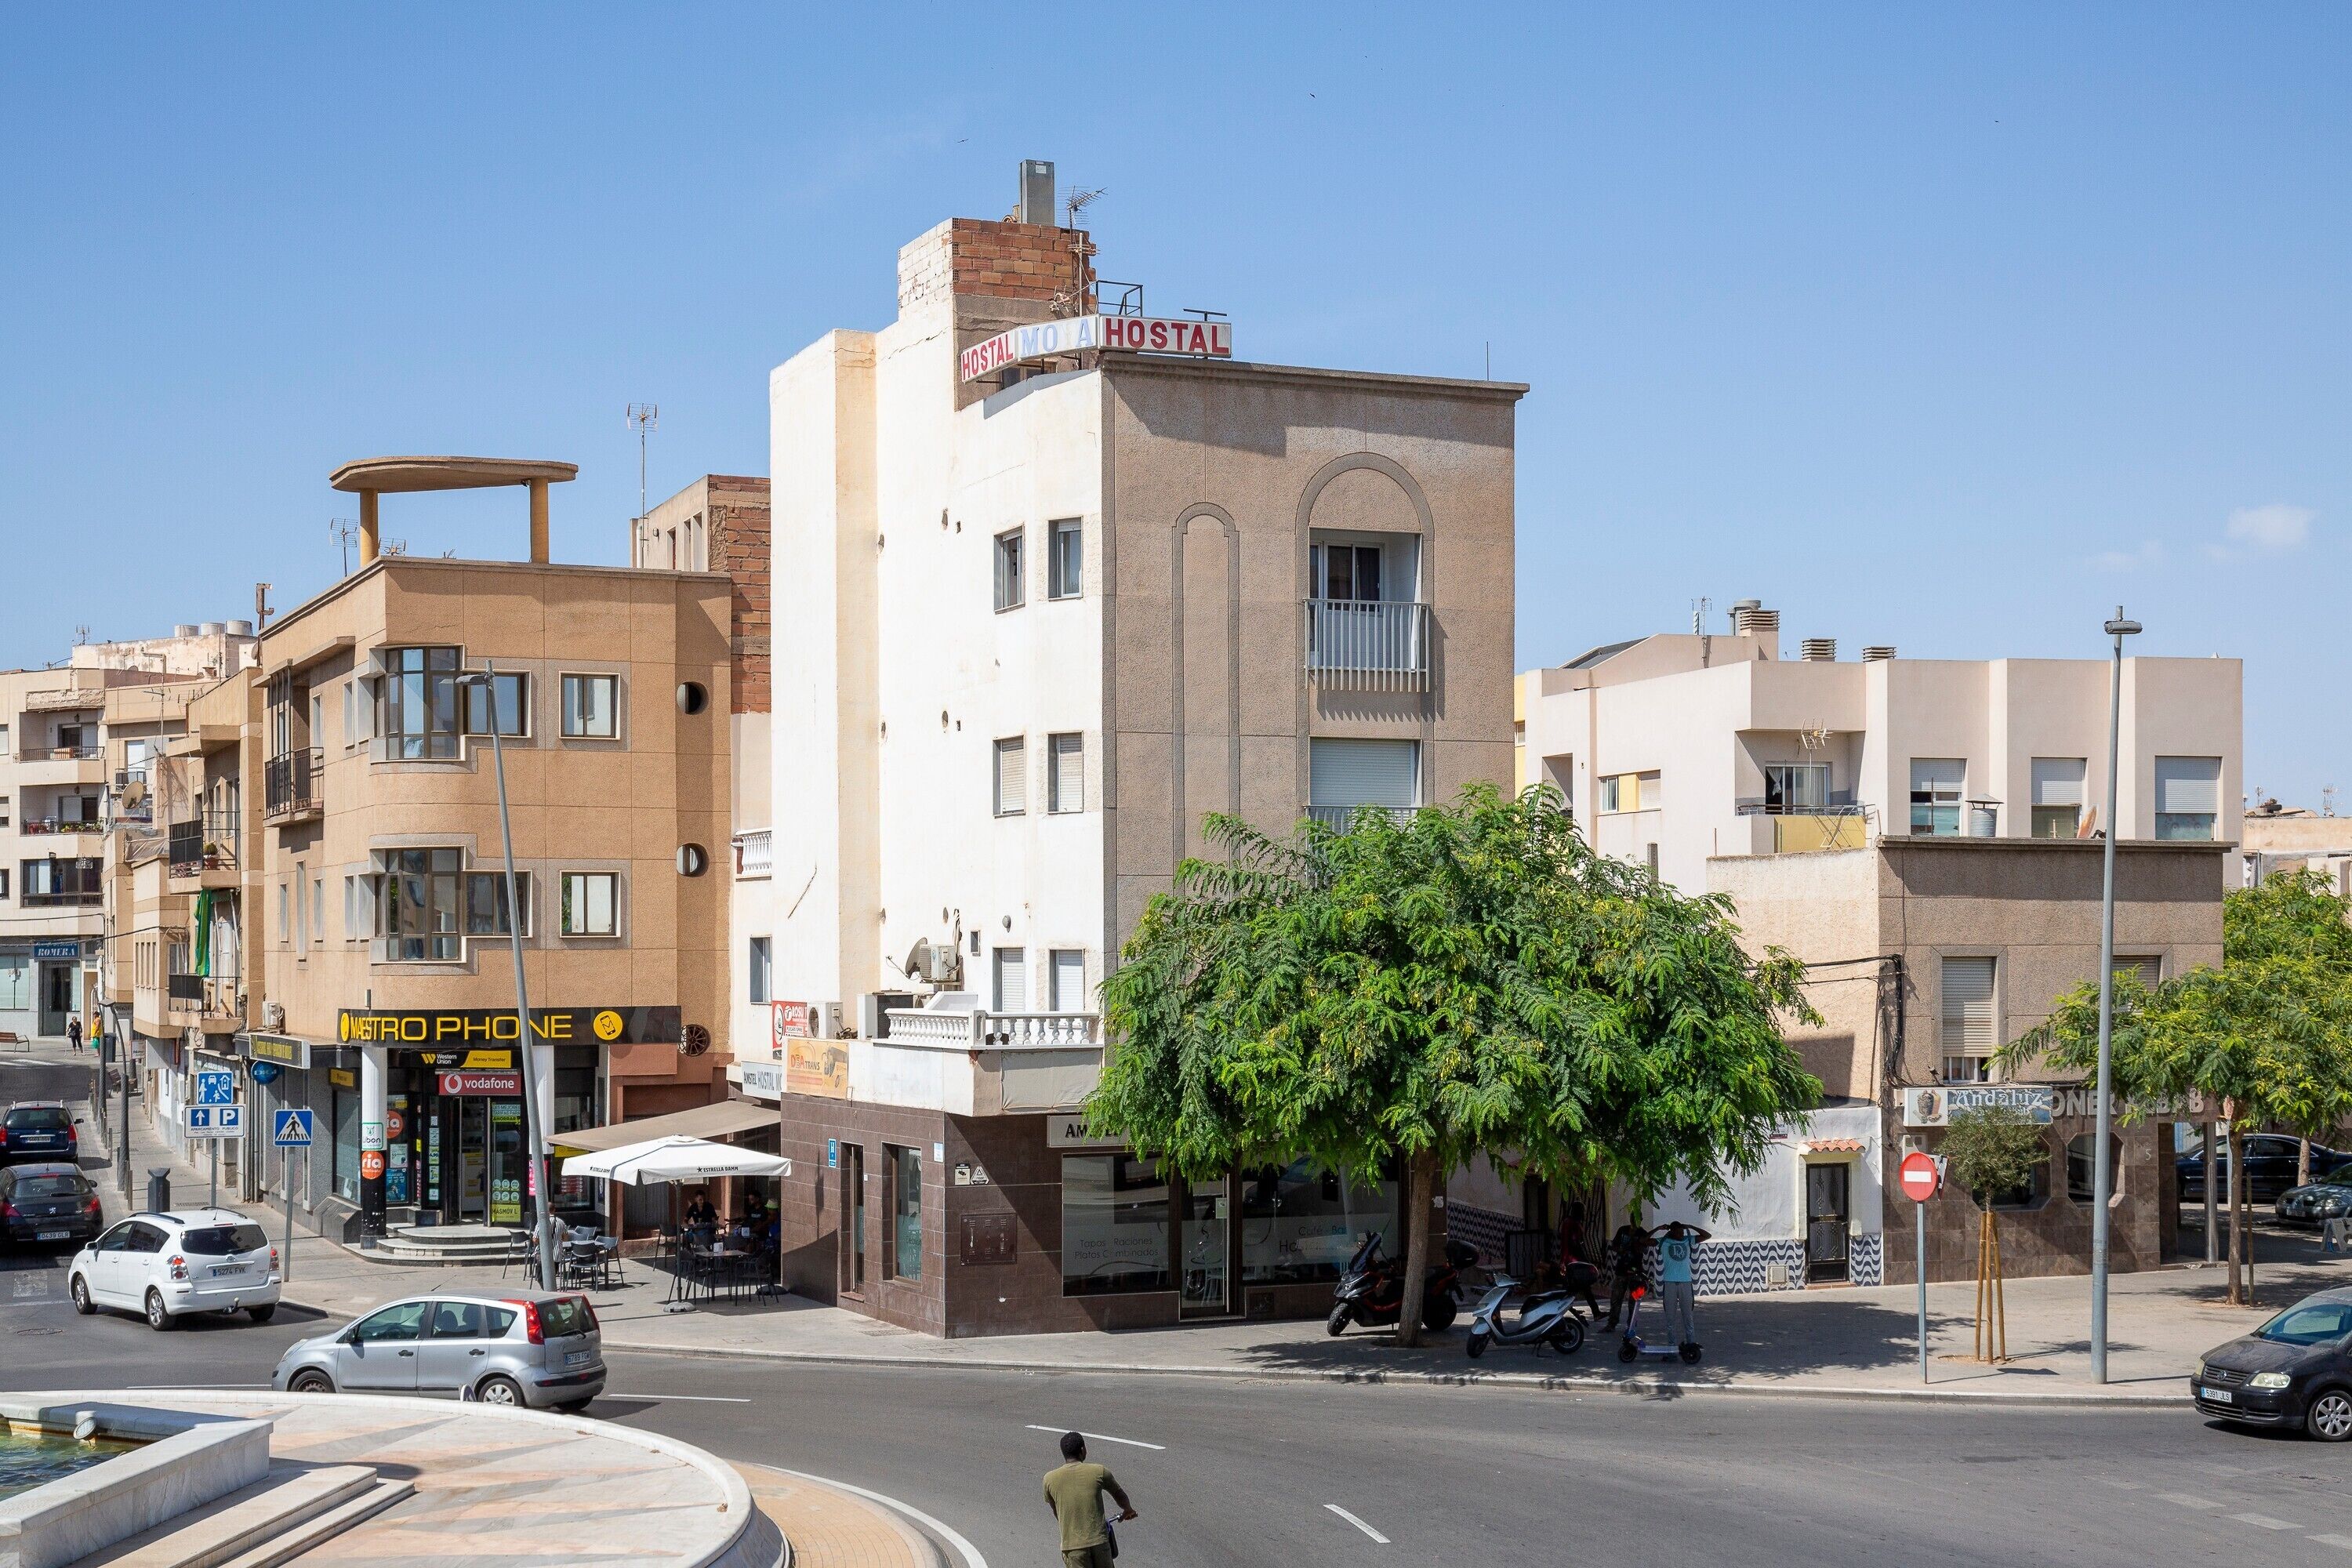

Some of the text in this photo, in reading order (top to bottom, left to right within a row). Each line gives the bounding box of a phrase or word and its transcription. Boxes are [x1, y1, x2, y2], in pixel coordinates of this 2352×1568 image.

[1105, 318, 1229, 354] HOSTAL
[961, 333, 1014, 381] HOSTAL
[350, 1015, 572, 1040] MAESTRO PHONE
[465, 1077, 514, 1089] vodafone
[743, 1072, 757, 1085] AMSTEL
[757, 1071, 775, 1091] HOSTAL
[1955, 1089, 2043, 1106] Andaluz
[223, 1109, 235, 1125] P
[361, 1153, 382, 1169] ria
[2145, 1149, 2151, 1160] 5
[1102, 1248, 1159, 1258] Cmbnados
[218, 1267, 233, 1276] 5274
[2206, 1389, 2218, 1399] 5391
